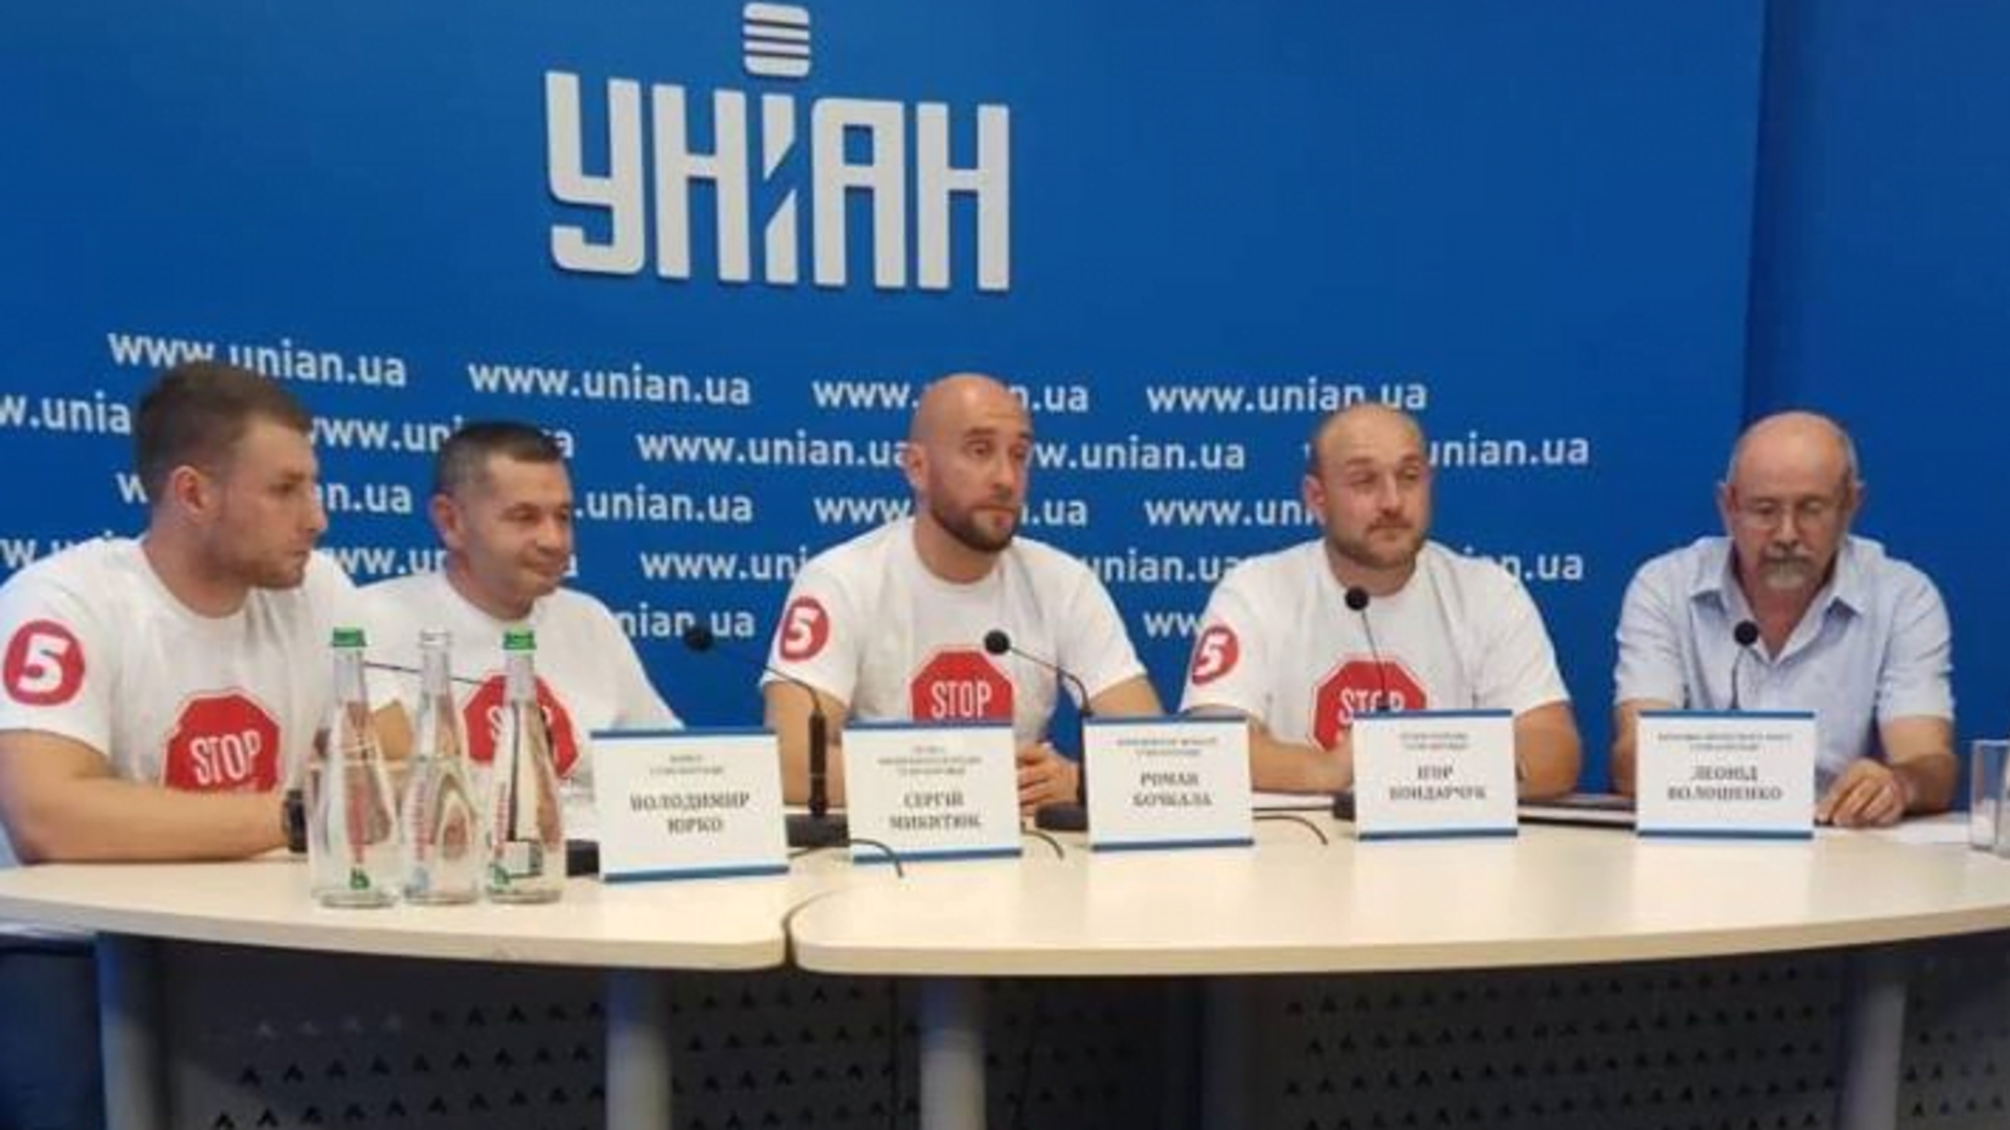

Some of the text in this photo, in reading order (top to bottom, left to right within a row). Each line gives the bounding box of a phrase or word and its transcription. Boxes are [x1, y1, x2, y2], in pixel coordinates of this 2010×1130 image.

[546, 71, 1010, 290] УНІАН
[107, 332, 408, 386] wwwunian.ua
[468, 363, 751, 405] www.unian.ua
[812, 381, 1089, 413] www.n.ua
[1146, 376, 1427, 412] www.unianua
[0, 389, 131, 435] w.unia
[1036, 434, 1245, 469] w.unian.ua
[575, 485, 753, 522] .unian.ua
[641, 545, 807, 581] www.uni
[784, 606, 819, 653] 5
[17, 634, 70, 693] 5
[1193, 632, 1228, 676] 5
[930, 680, 992, 718] STOP
[189, 729, 262, 785] STOP
